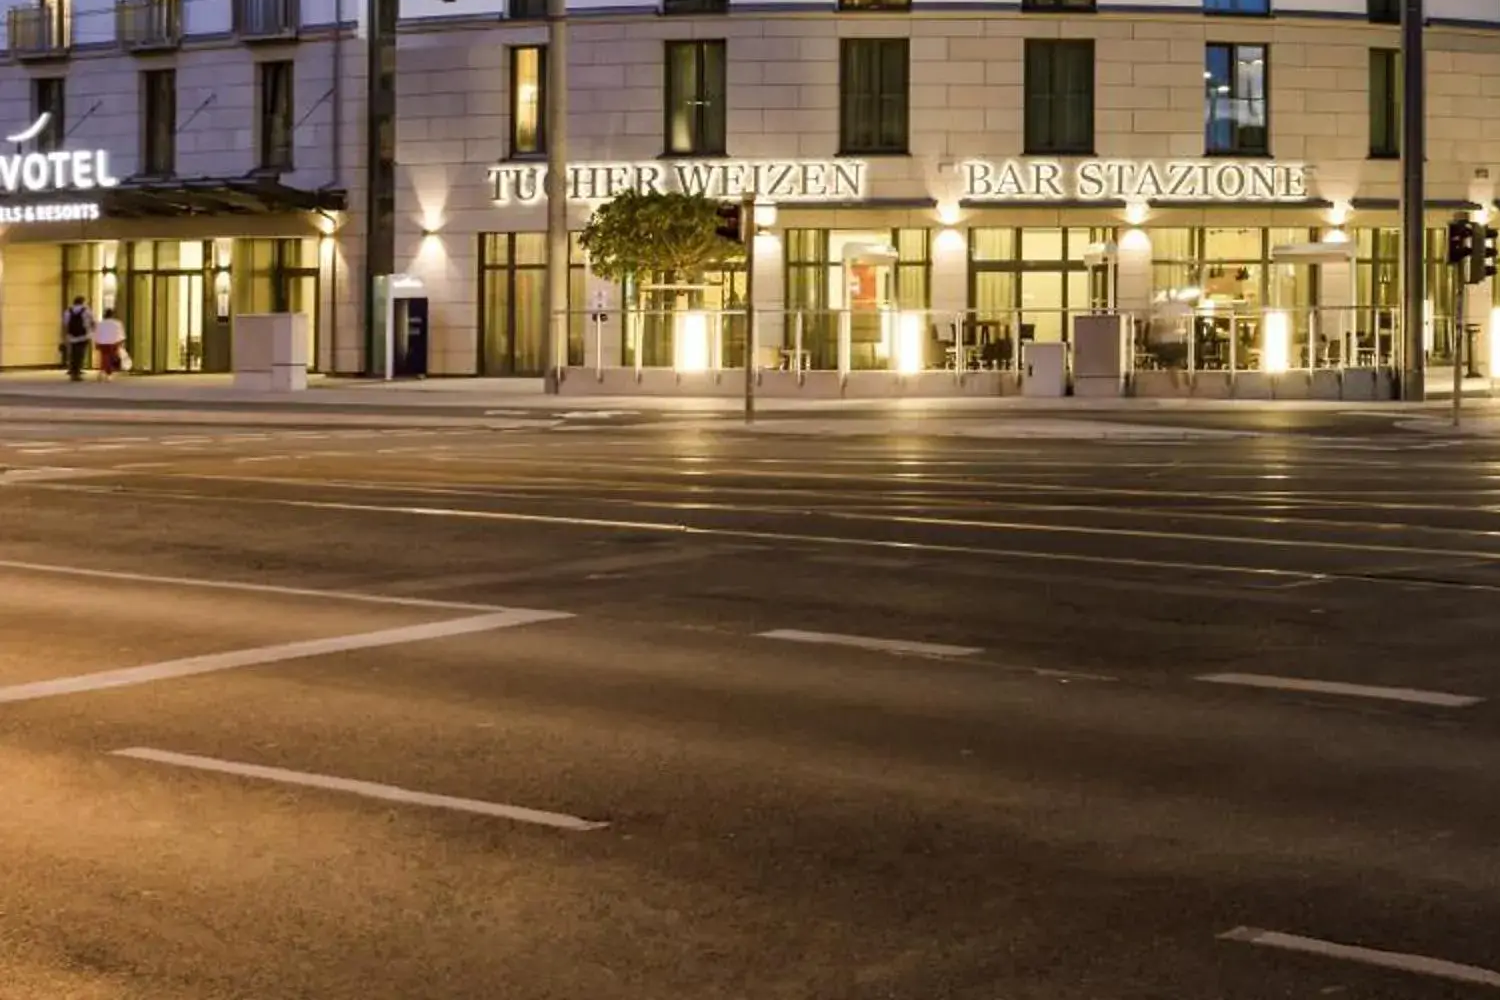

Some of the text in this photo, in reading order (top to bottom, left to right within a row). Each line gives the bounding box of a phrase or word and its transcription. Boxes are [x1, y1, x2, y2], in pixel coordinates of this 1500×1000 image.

[487, 162, 864, 201] TUHER WEIZEN
[966, 162, 1309, 198] BAR STAZIONE
[36, 202, 99, 221] RESORTS
